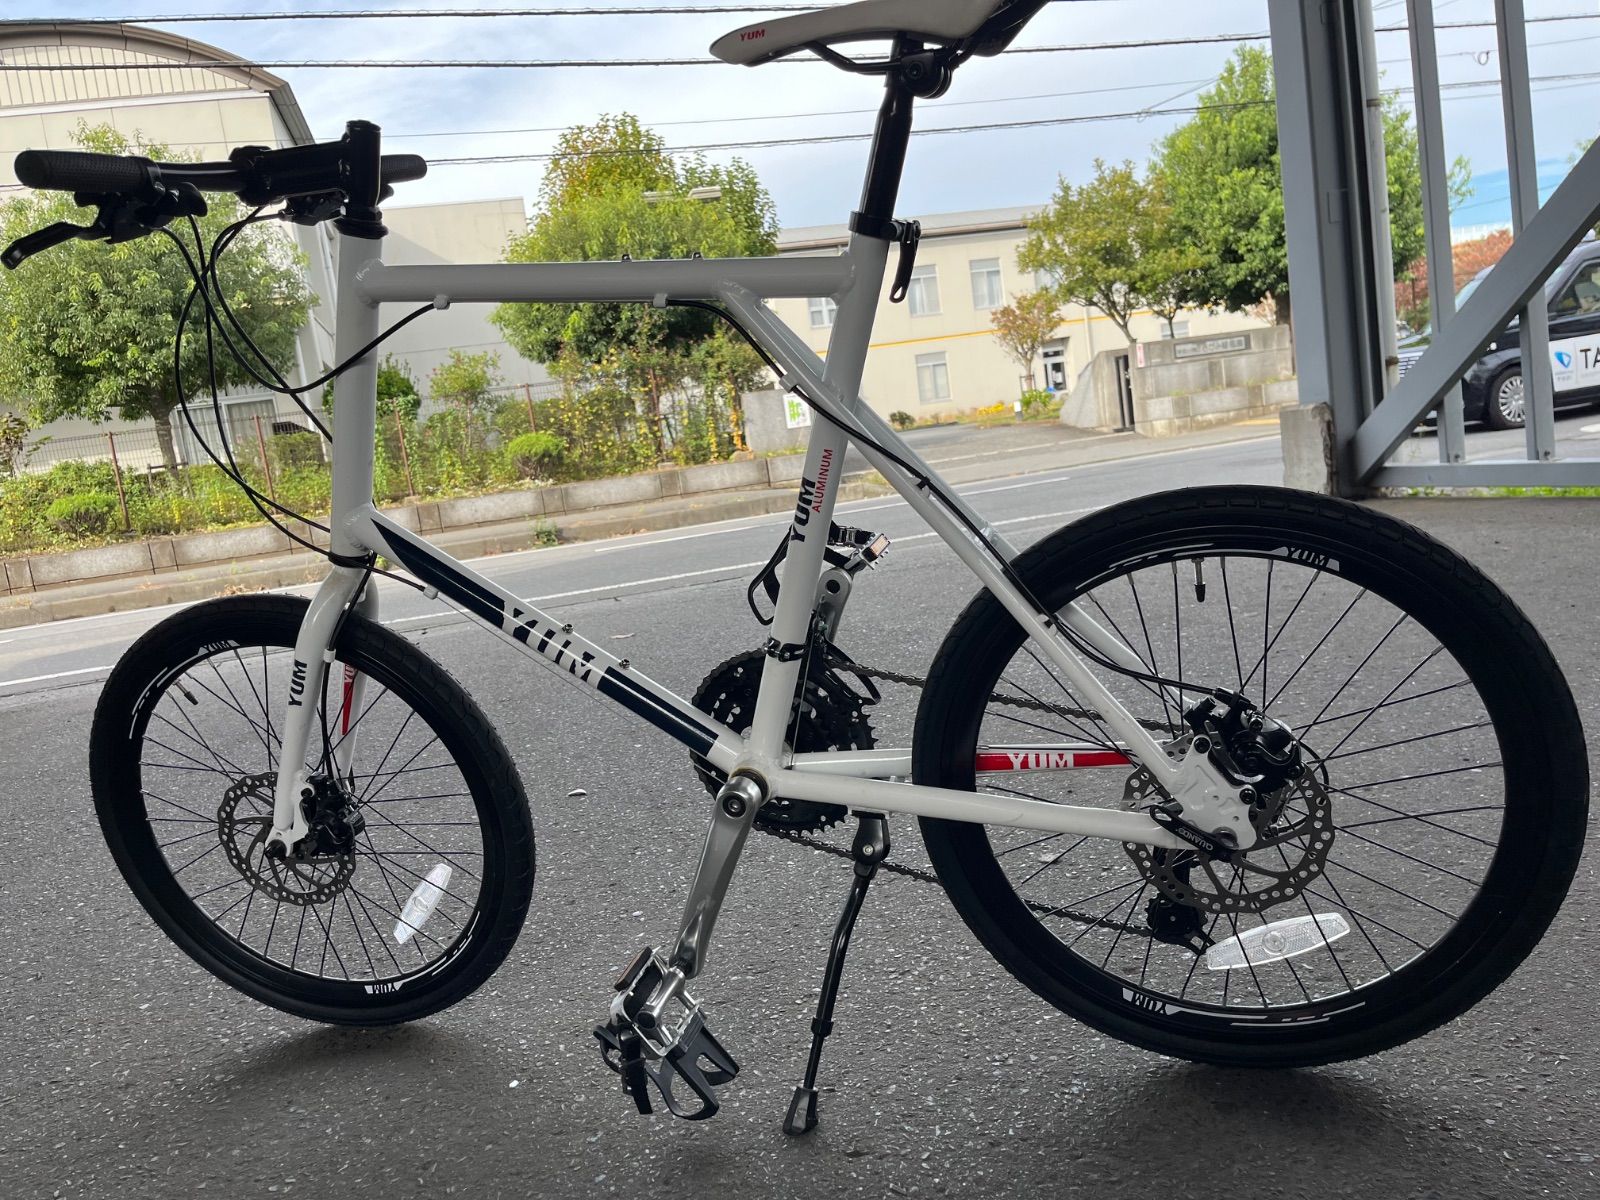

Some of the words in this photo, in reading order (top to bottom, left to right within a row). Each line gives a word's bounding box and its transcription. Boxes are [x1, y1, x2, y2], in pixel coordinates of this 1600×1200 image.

[740, 29, 765, 42] YUM
[811, 448, 833, 513] ALUMINUM
[790, 476, 816, 543] YUM
[1286, 546, 1330, 568] YUM
[501, 600, 609, 690] YUM
[288, 659, 308, 706] YUM
[1007, 752, 1075, 771] YUM
[1178, 827, 1214, 851] QUANDO
[371, 982, 397, 994] YUM
[1130, 990, 1167, 1015] YUM
